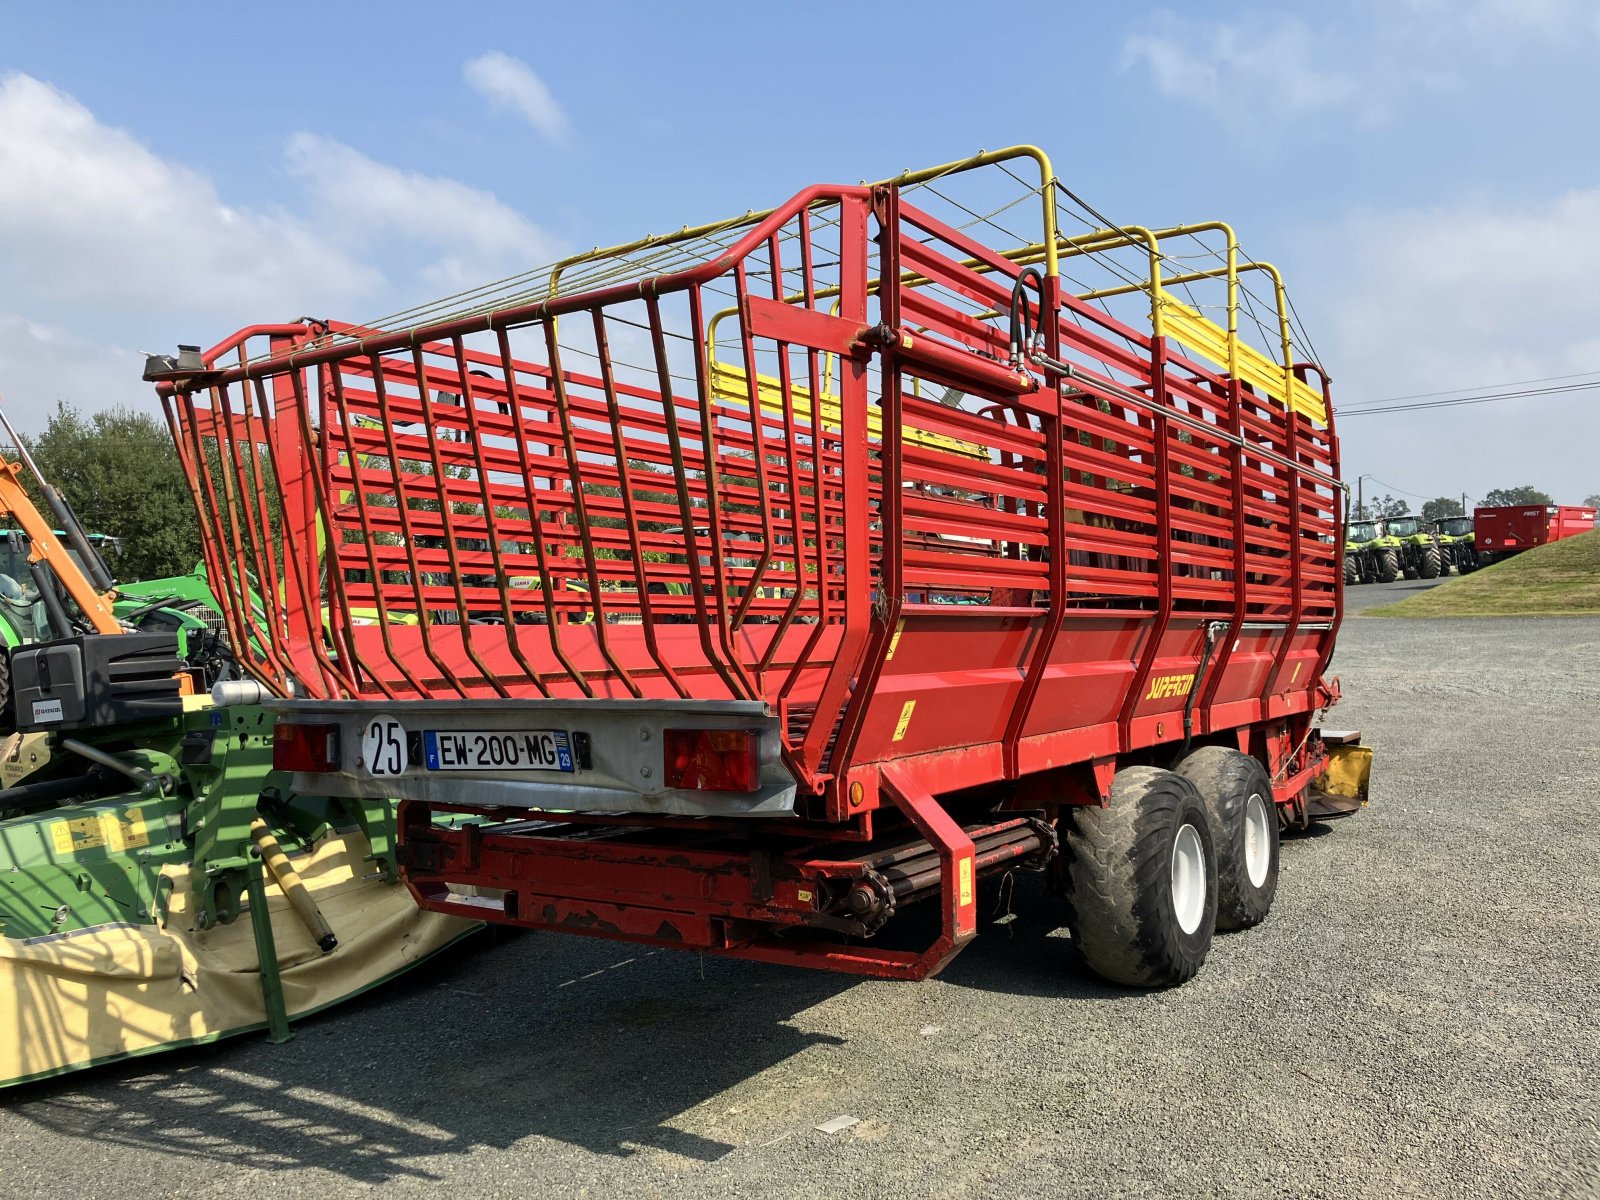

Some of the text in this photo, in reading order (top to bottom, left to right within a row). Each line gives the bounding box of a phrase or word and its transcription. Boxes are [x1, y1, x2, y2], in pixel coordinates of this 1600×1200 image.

[370, 722, 402, 775] 25
[429, 734, 572, 767] F EW-200-MG 29
